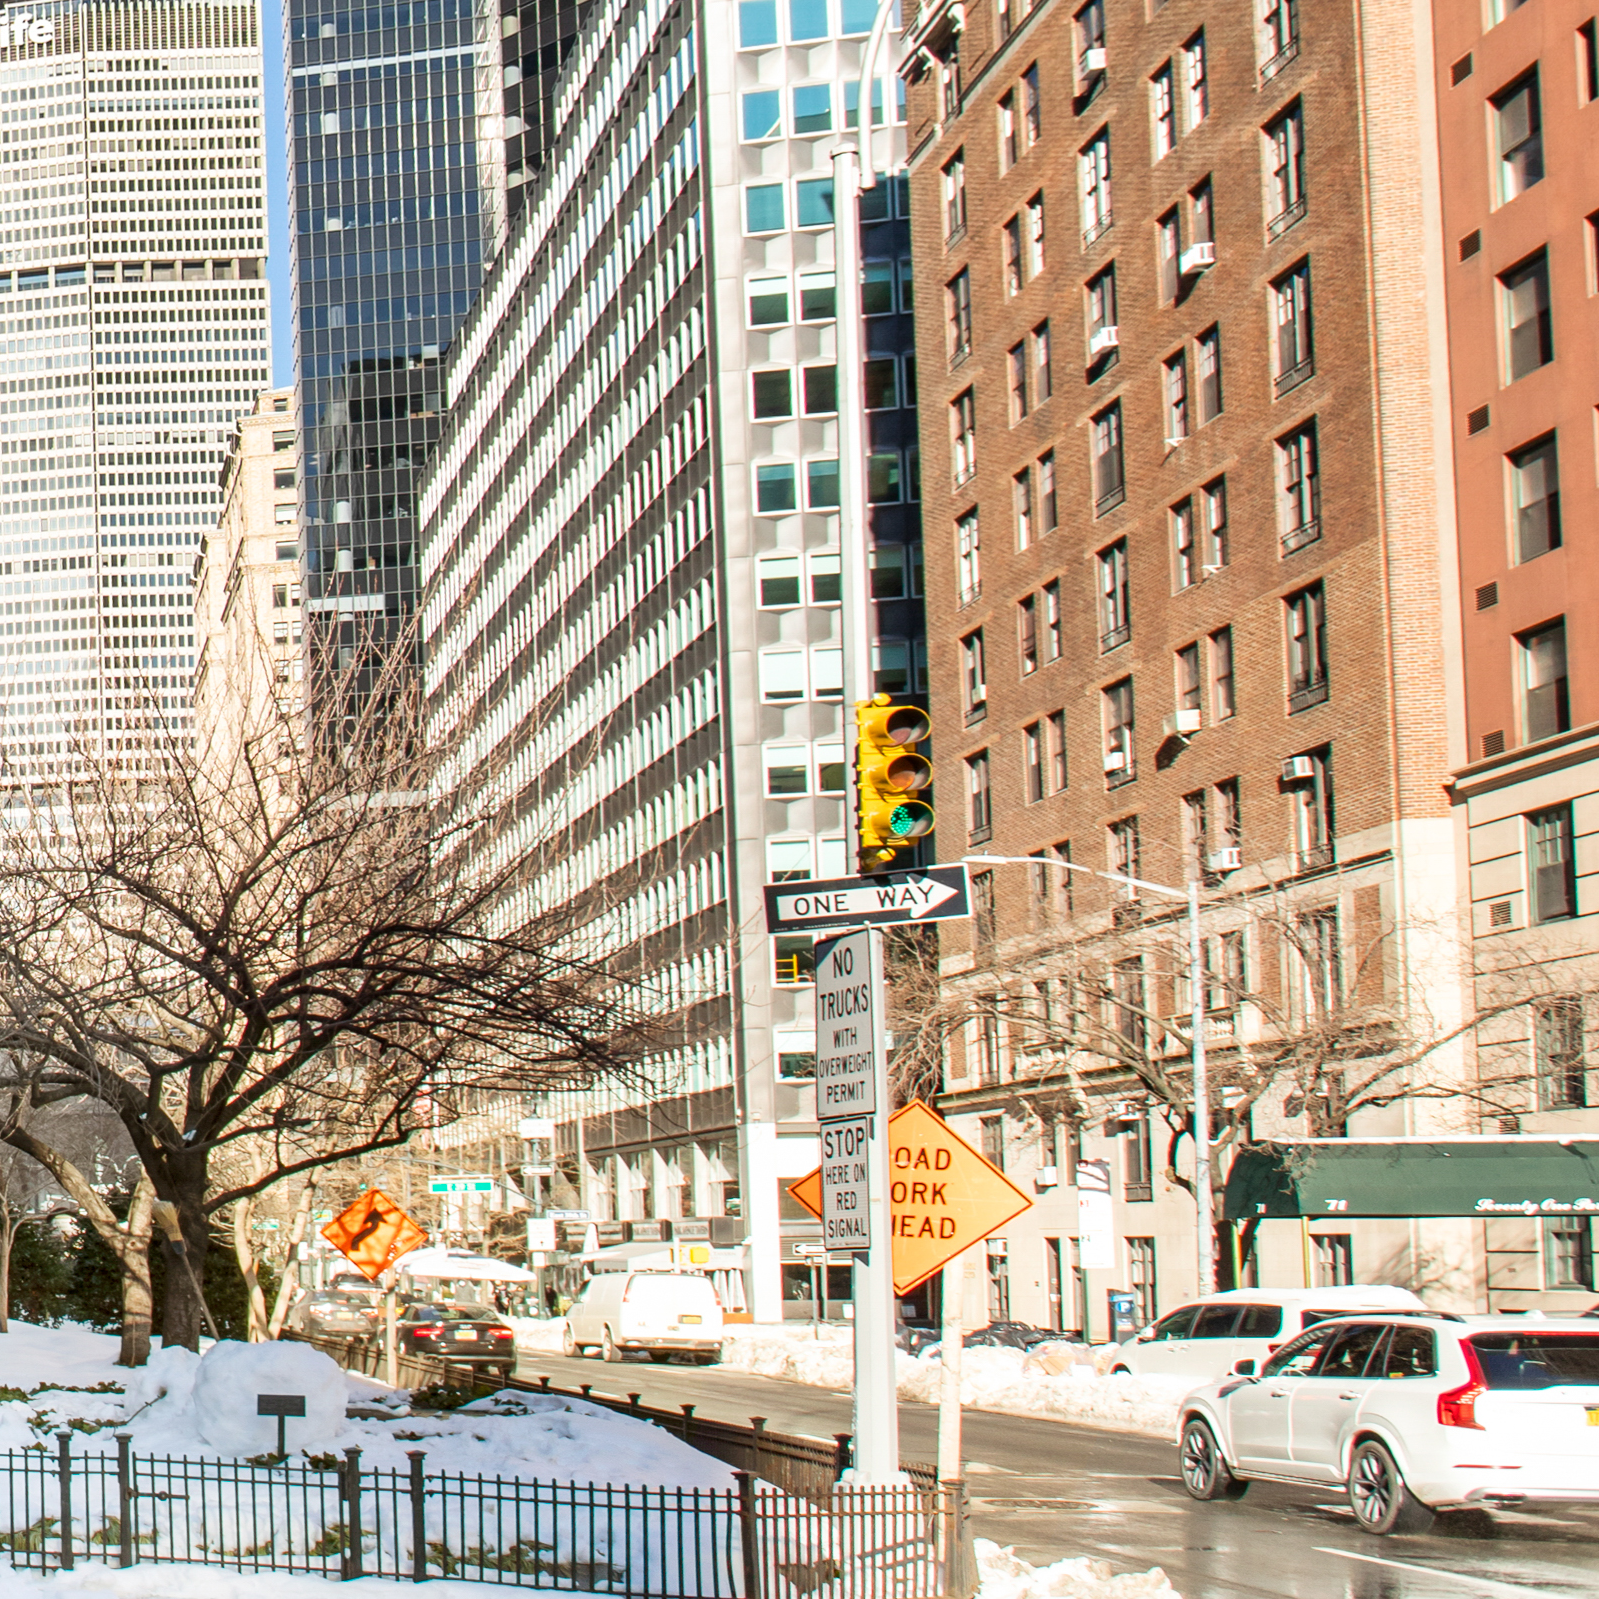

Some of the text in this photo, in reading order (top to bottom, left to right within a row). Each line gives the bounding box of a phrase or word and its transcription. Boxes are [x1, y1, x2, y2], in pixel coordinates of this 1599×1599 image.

[794, 884, 934, 915] ONE WAY
[833, 947, 853, 978] NO
[820, 983, 869, 1021] TRUCKS
[833, 1026, 857, 1049] WITH
[819, 1051, 872, 1078] OVERWEIGHT
[827, 1081, 865, 1104] PERMIT
[824, 1127, 865, 1159] STOP
[895, 1147, 951, 1171] OAD
[825, 1162, 866, 1185] HERE ON
[836, 1191, 857, 1211] RED
[890, 1181, 947, 1205] ORK
[1324, 1199, 1348, 1211] 71
[1474, 1198, 1540, 1216] Seventy
[1540, 1198, 1572, 1212] One
[828, 1217, 867, 1238] SIGNAL
[892, 1215, 956, 1239] EAD
